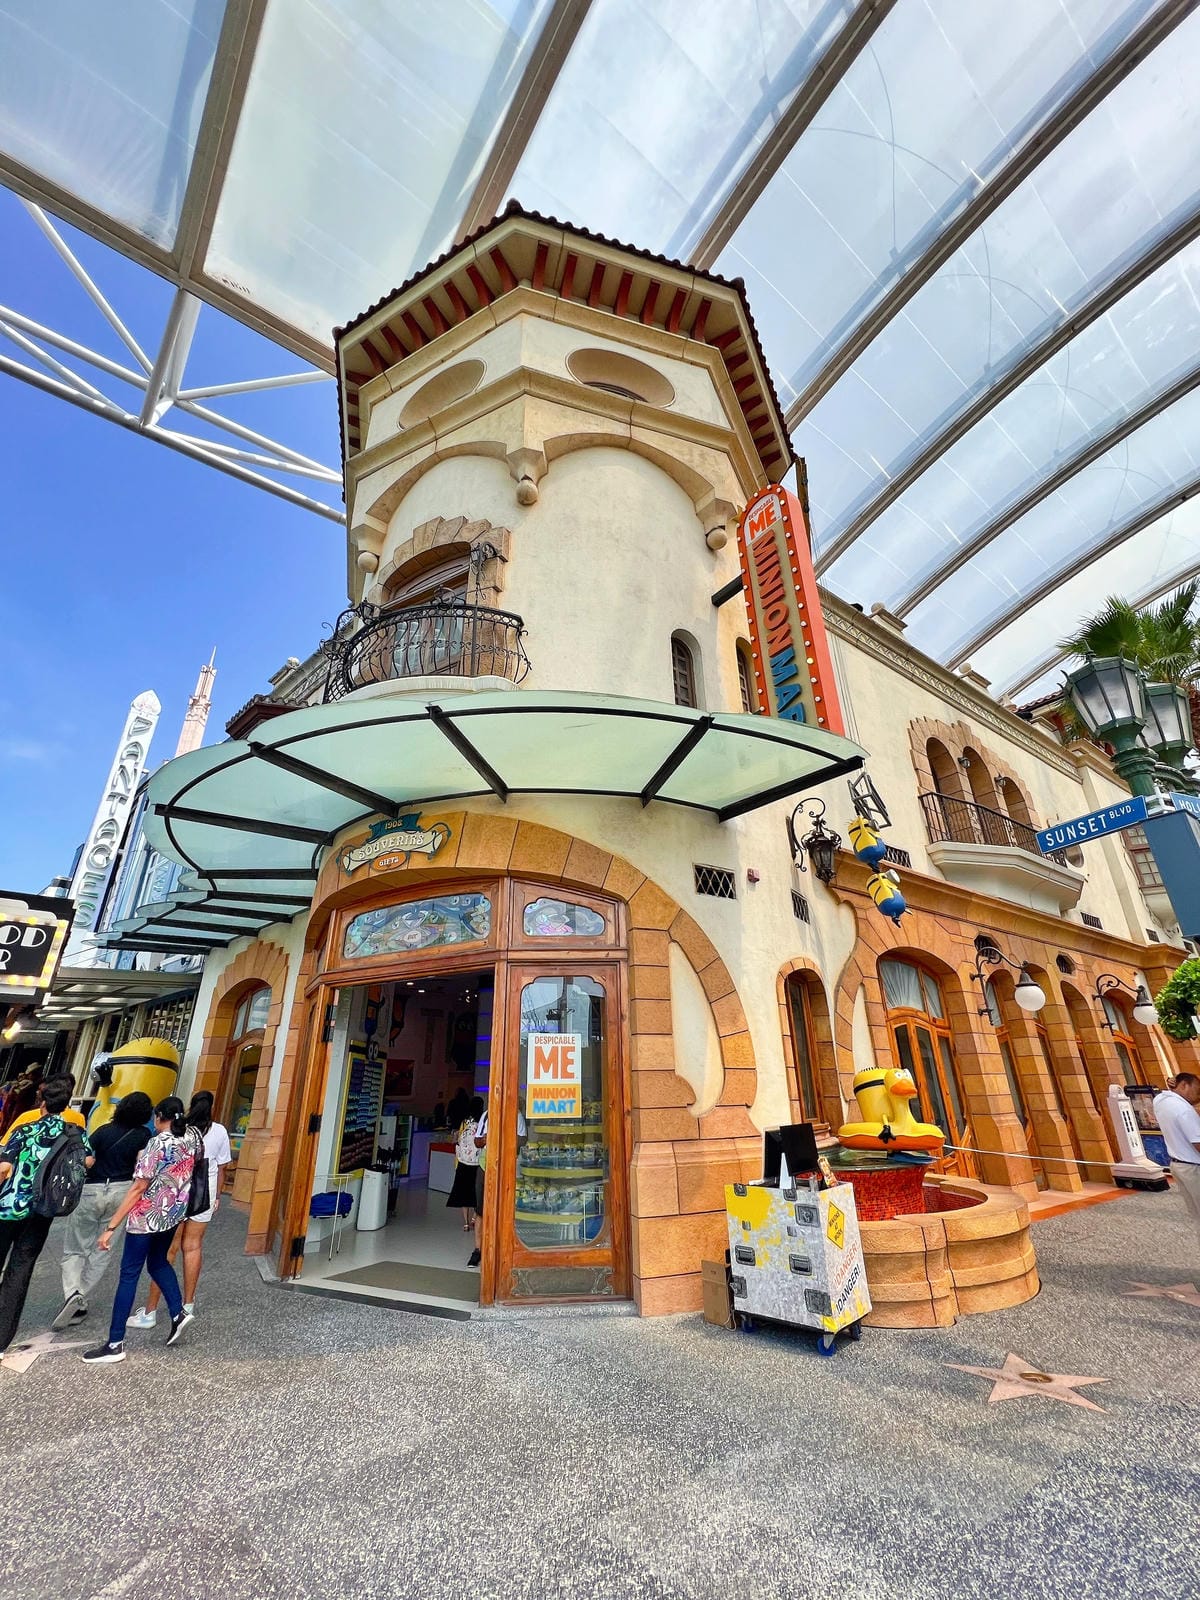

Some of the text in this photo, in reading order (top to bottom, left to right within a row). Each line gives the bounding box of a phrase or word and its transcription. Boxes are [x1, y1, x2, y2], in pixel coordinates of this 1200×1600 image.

[748, 502, 777, 540] ME
[752, 529, 794, 657] MINION
[73, 716, 152, 928] PANTAGES
[1045, 805, 1135, 847] SUNSET BLVD.
[534, 1036, 575, 1045] DESPICABLE
[533, 1046, 576, 1079] ME
[532, 1087, 576, 1099] MINION
[532, 1100, 576, 1114] MART
